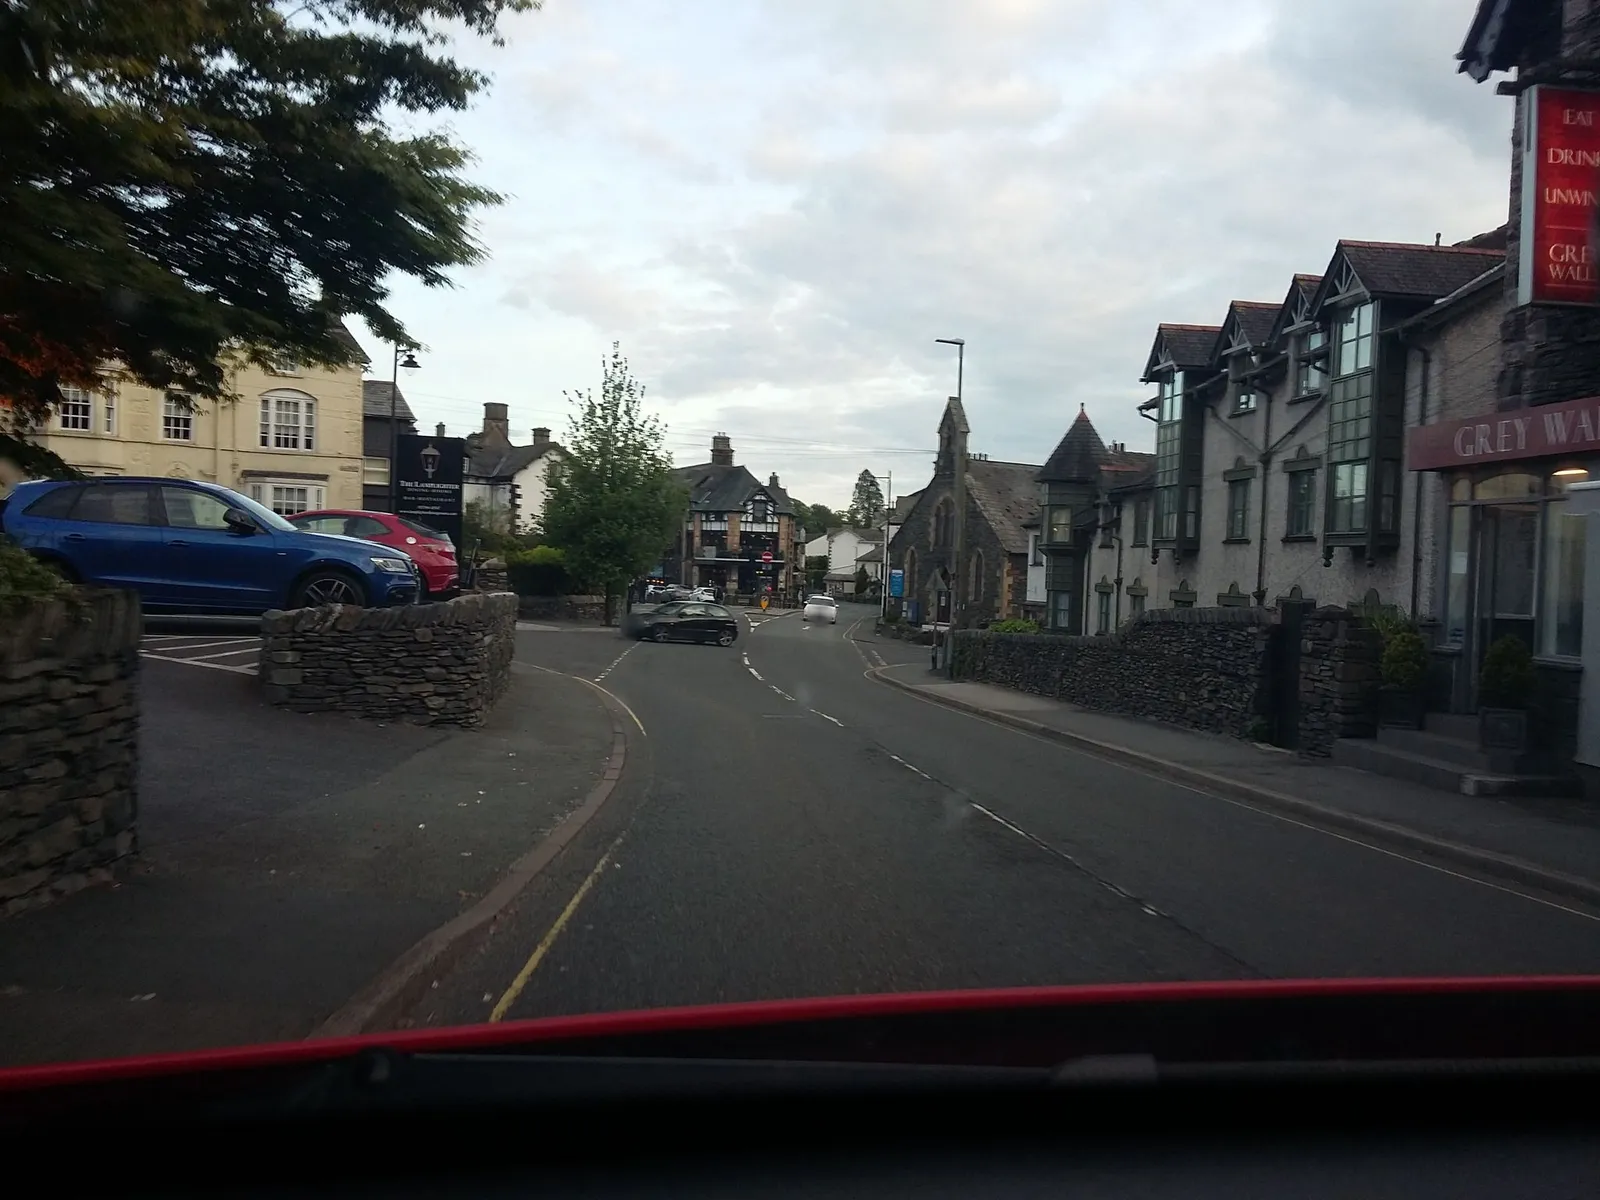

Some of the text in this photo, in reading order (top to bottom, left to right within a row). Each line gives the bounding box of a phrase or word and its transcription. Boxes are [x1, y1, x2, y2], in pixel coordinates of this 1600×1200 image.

[1562, 108, 1595, 127] EAT
[1453, 405, 1600, 457] GREY WA
